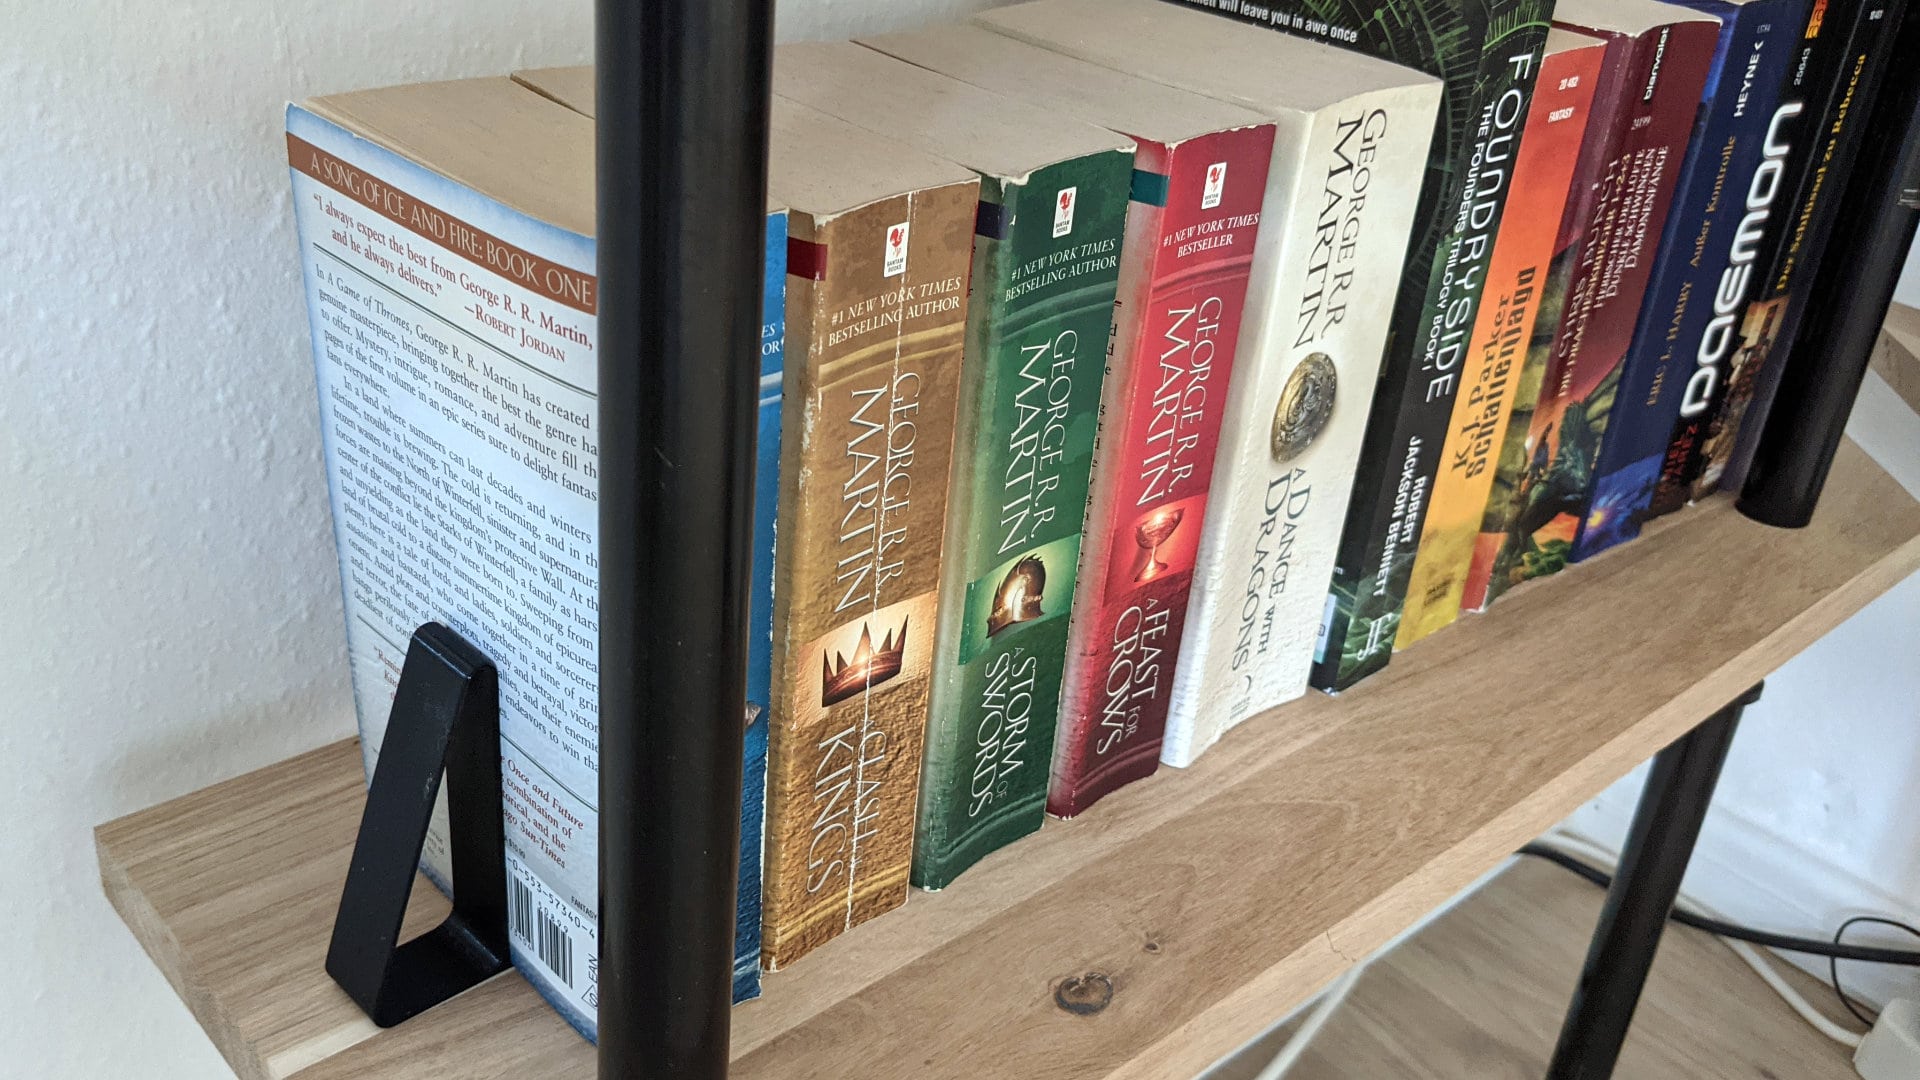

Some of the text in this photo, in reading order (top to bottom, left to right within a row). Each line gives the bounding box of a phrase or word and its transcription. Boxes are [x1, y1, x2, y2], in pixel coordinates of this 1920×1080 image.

[1219, 0, 1238, 13] will
[1240, 0, 1268, 20] leave
[1270, 10, 1290, 26] you
[1292, 13, 1303, 29] in
[1304, 21, 1328, 36] awe
[1330, 26, 1358, 43] once
[1643, 27, 1670, 101] blanvalet
[1477, 101, 1495, 137] THE
[1548, 106, 1575, 123] FANTASY
[1733, 53, 1760, 118] HEYNE
[1336, 108, 1388, 264] GEORGE
[1690, 135, 1736, 269] Außer Kontrolle
[1777, 257, 1794, 291] Der
[1824, 138, 1837, 162] zu
[1831, 53, 1867, 134] Rebecca
[311, 152, 593, 306] A SONG OF ICE AND FIRE: BOOK ONE
[325, 200, 354, 229] always
[357, 221, 386, 247] expect
[389, 235, 405, 256] the
[407, 243, 428, 269] best
[431, 256, 457, 284] from
[460, 272, 500, 308] George
[503, 294, 517, 315] R.
[520, 302, 535, 324] R.
[539, 311, 593, 350] Martin,
[332, 228, 348, 247] and
[350, 234, 362, 254] he
[364, 244, 395, 274] always
[1005, 255, 1118, 302] BESTSELLING AUTHOR
[1010, 238, 1116, 282] #1 NEW YORK TIMES
[1163, 211, 1260, 249] #1 NEW YORK TIMES
[1177, 233, 1234, 258] BESTSELLER
[1292, 110, 1367, 350] MARTIN
[1437, 236, 1464, 310] TRILOGY
[1556, 159, 1619, 357] CHRIS BUNCH
[316, 263, 591, 430] In A Game of Thrones, George R. R. Martin has created
[519, 327, 566, 363] JORDAN
[828, 295, 961, 348] BESTSELLING AUTHOR
[831, 276, 962, 326] #1 NEW YORK TIMES
[1424, 315, 1444, 362] BOOK
[1467, 295, 1510, 408] Parker
[1666, 281, 1693, 341] HARRY
[401, 335, 577, 448] bringing together the best the genre
[1040, 329, 1078, 470] GEORGE
[1136, 305, 1197, 507] MARTIN
[1179, 296, 1223, 430] GEORGE
[835, 382, 888, 613] MARTIN
[884, 372, 921, 526] GEORGE
[997, 338, 1051, 556] MARTIN
[487, 472, 592, 544] decades and winters
[1257, 467, 1311, 655] A DANCE WITH
[1373, 435, 1424, 597] JACKSON BENNETT
[1400, 475, 1428, 544] ROBERT
[1231, 467, 1293, 672] DRAGONS
[1011, 646, 1025, 660] A
[1096, 605, 1143, 755] CROWS
[1124, 597, 1171, 738] A FEAST FOR
[968, 652, 1010, 818] SWORDS
[998, 654, 1037, 780] STORM
[506, 777, 559, 829] combination
[562, 826, 573, 840] of
[507, 759, 585, 831] Once and Future
[533, 818, 549, 838] and
[552, 833, 566, 853] the
[806, 724, 857, 893] KINGS
[852, 731, 887, 843] CLASH
[520, 820, 566, 869] Sun-Times
